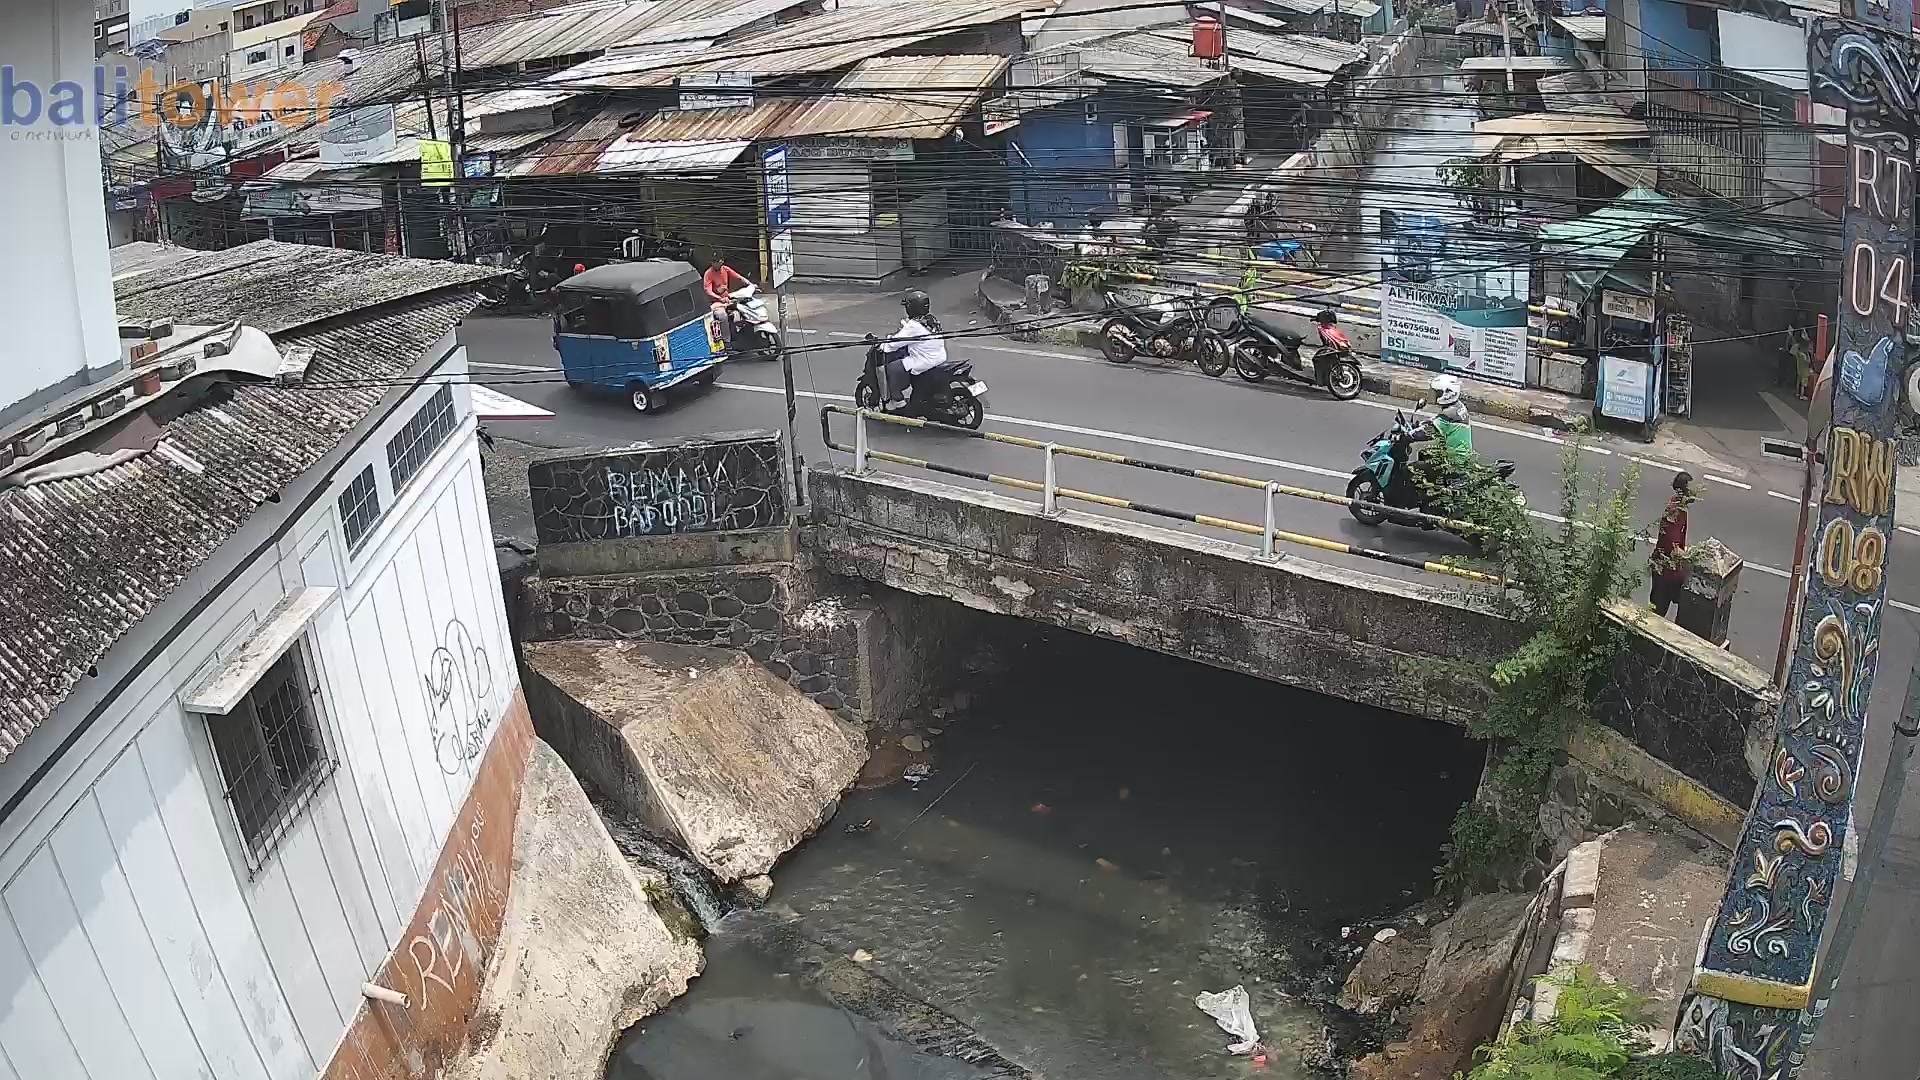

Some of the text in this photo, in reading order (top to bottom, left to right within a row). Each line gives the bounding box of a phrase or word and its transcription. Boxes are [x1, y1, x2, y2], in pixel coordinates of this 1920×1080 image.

[1853, 144, 1912, 219] RT
[1388, 287, 1403, 299] AL
[1406, 289, 1457, 309] HIKMAH
[1852, 243, 1909, 324] 04
[1388, 336, 1405, 349] BSI
[1824, 427, 1897, 516] RW
[1817, 517, 1887, 595] 08
